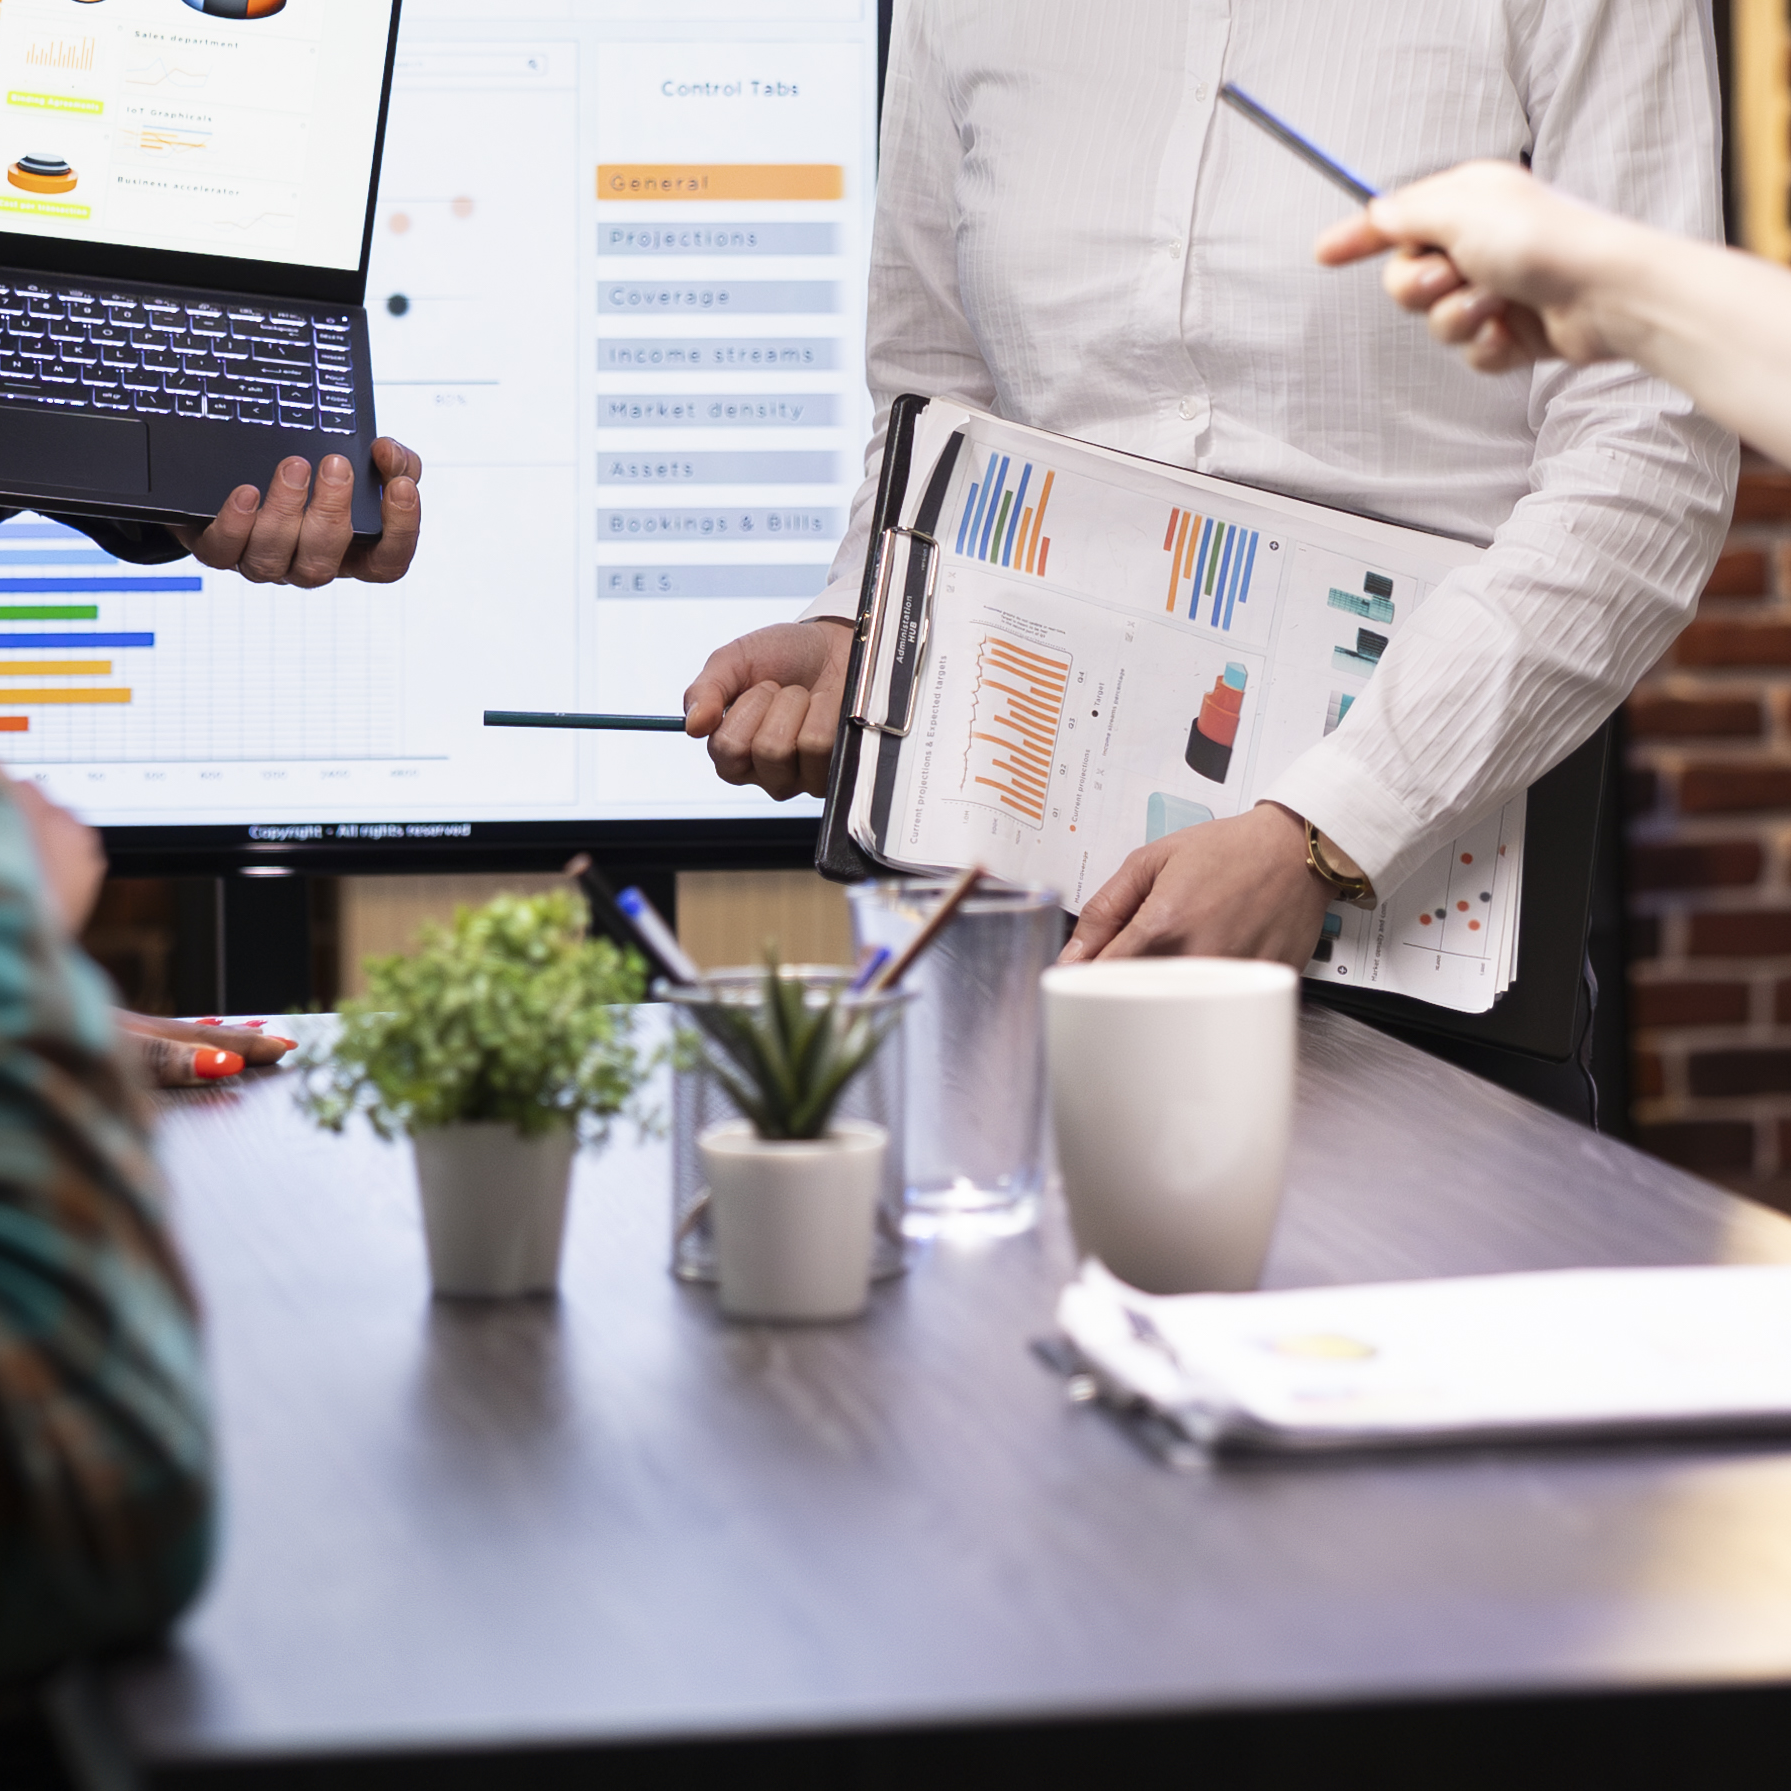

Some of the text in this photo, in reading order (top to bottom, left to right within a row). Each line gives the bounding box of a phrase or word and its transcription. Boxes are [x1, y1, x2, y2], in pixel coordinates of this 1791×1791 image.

[135, 30, 166, 41] Sales
[170, 34, 240, 49] department
[661, 80, 799, 97] Control Tabs
[11, 93, 100, 112] Binding Agreements
[126, 106, 213, 123] IoT Graphicals
[117, 176, 168, 189] Business
[173, 182, 240, 196] accelerator
[610, 175, 708, 191] General
[20, 201, 35, 211] per
[37, 203, 88, 216] transaction
[610, 229, 758, 249] Projections
[610, 286, 730, 307] Coverage
[609, 347, 814, 364] Income streams
[609, 402, 804, 422] Market density
[609, 462, 693, 477] Assets
[609, 512, 822, 535] Bookings & Bills
[896, 595, 913, 664] Administation
[908, 621, 918, 643] HUB
[1077, 671, 1085, 684] Q4
[1094, 682, 1105, 707] Target
[1108, 705, 1118, 732] streams
[1114, 668, 1126, 705] percentage
[1068, 717, 1076, 730] Q3
[910, 655, 948, 845] Current projections & Expected targets
[1059, 763, 1067, 776] Q2
[1071, 749, 1091, 823] Current projections
[1052, 807, 1059, 818] Q1
[248, 823, 471, 841] Copyright All rights reserved
[1074, 850, 1089, 904] Market coverage
[1371, 958, 1380, 982] Market
[1378, 918, 1386, 934] and
